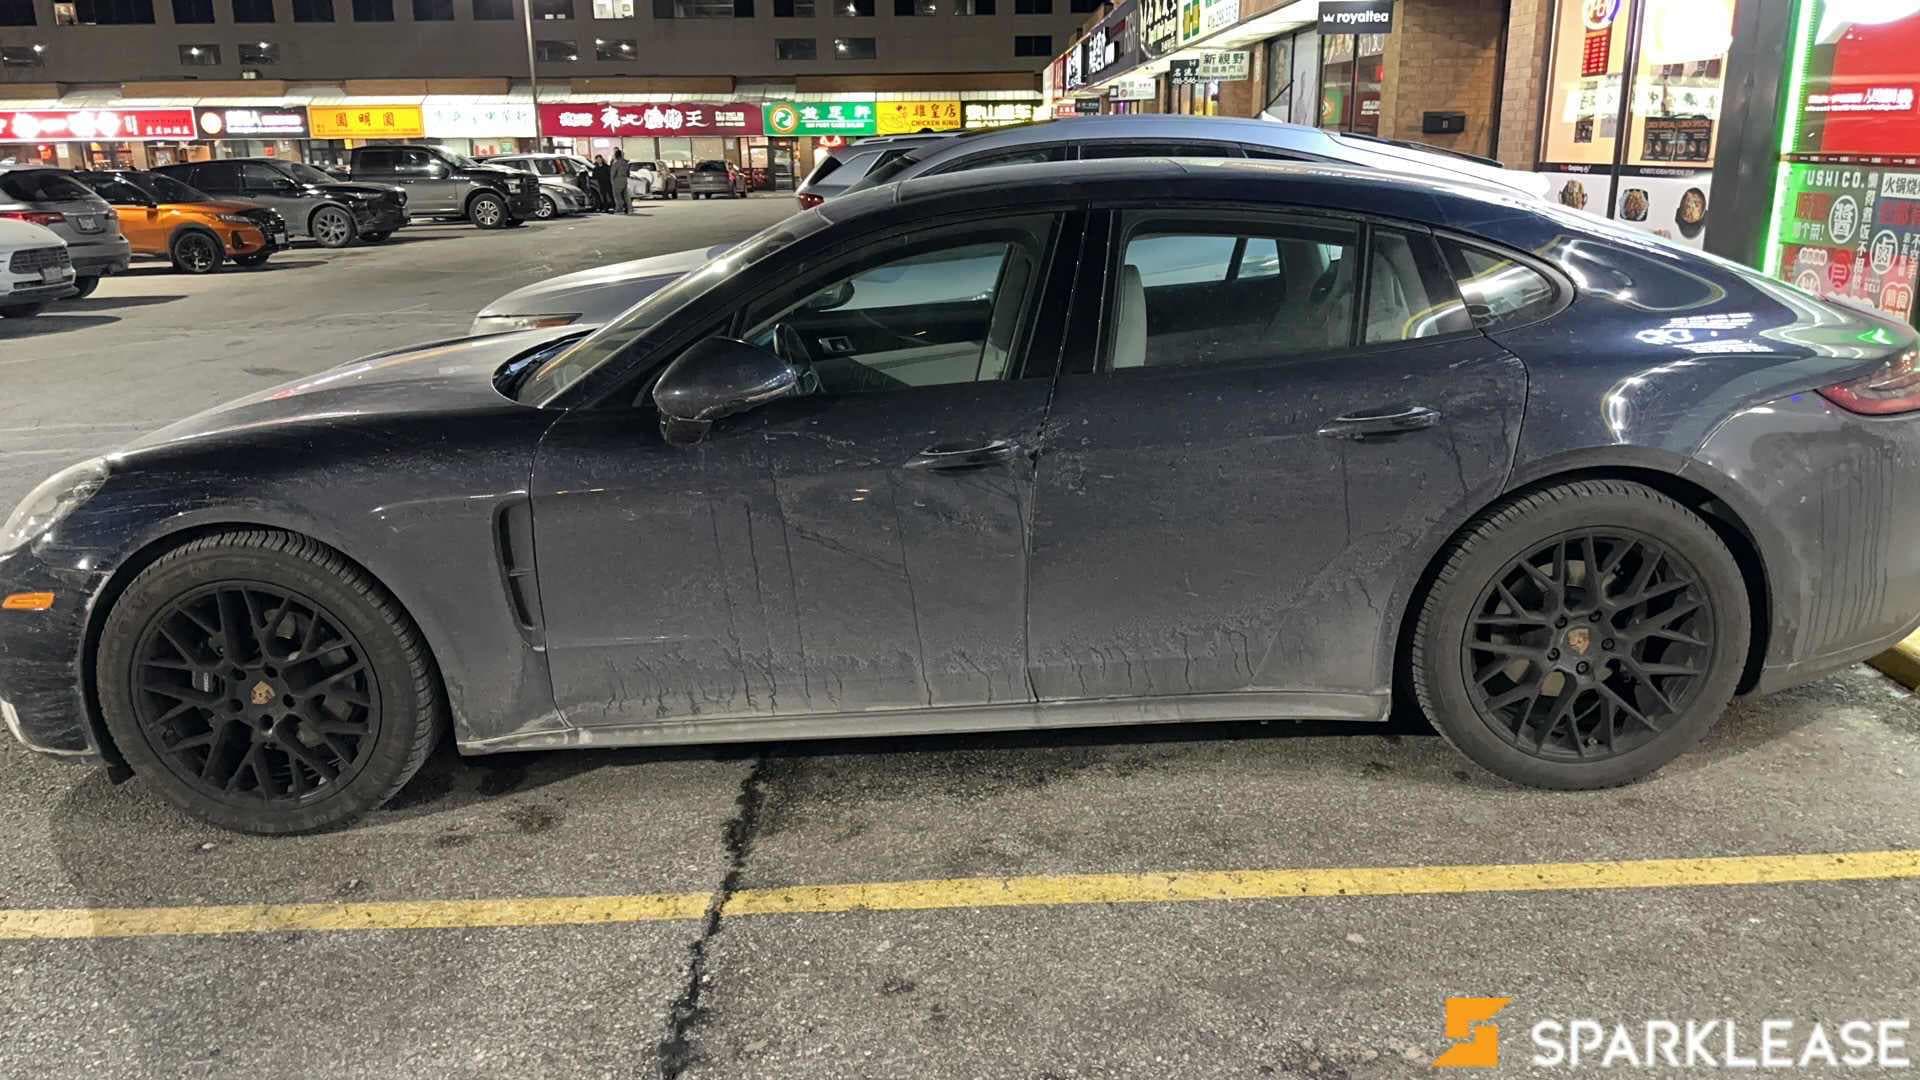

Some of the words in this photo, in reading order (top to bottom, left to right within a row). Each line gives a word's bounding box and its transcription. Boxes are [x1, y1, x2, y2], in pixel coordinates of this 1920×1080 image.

[1336, 10, 1389, 25] royaltea
[1203, 52, 1244, 65] 新視野
[912, 119, 940, 127] CHICKEN
[942, 119, 959, 127] KING
[1799, 169, 1839, 187] USHI
[1883, 176, 1920, 195] 火锅烧
